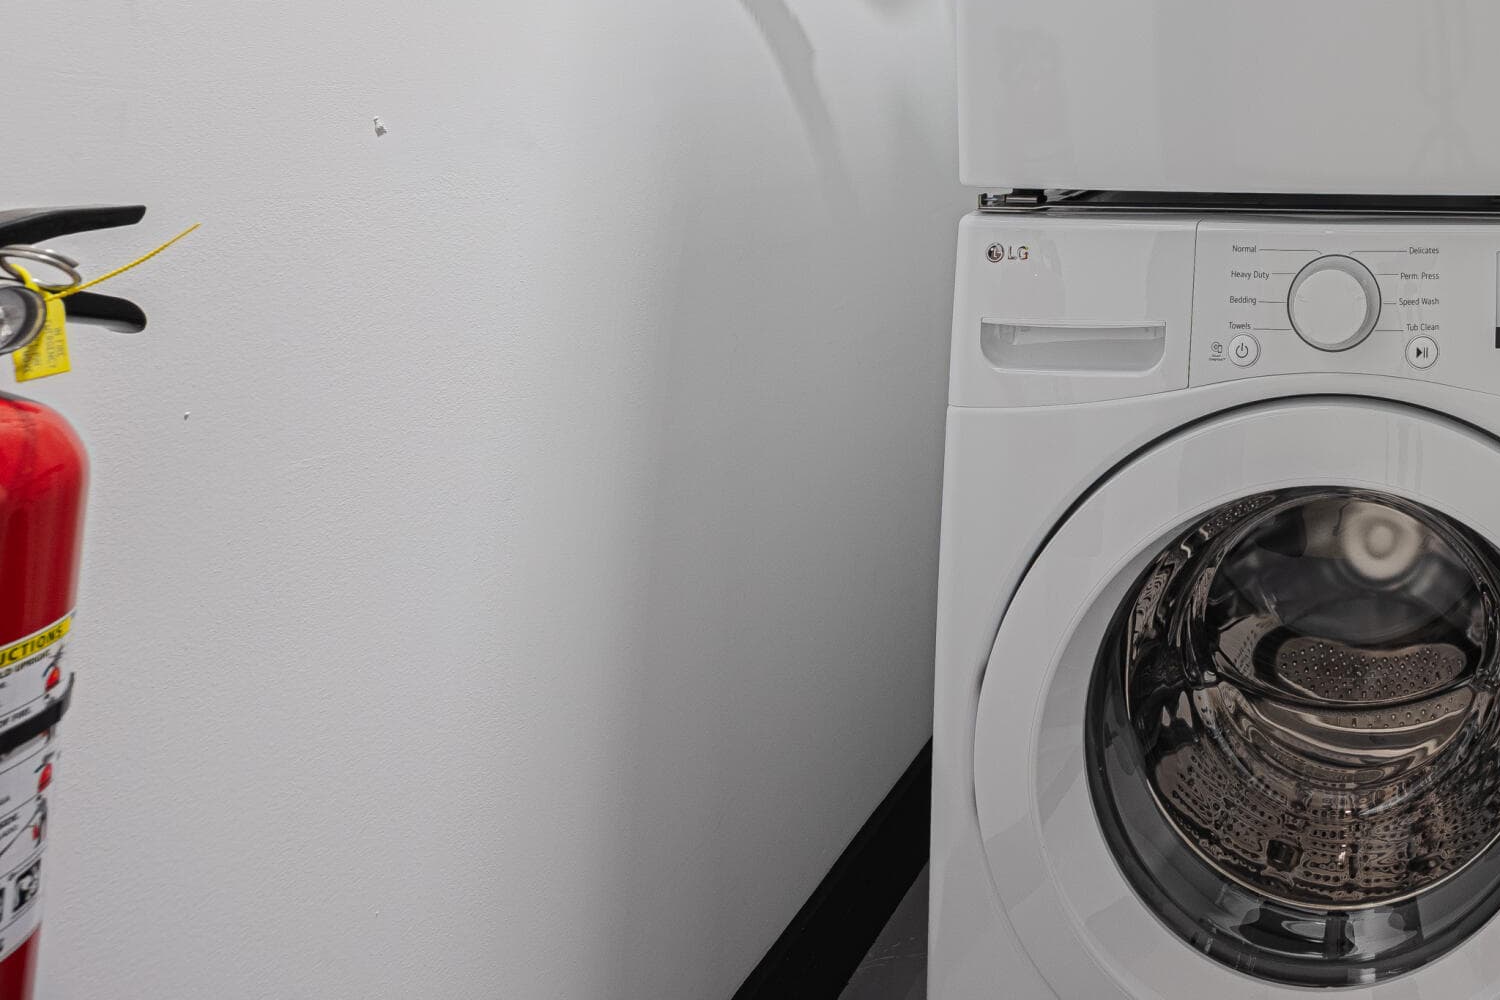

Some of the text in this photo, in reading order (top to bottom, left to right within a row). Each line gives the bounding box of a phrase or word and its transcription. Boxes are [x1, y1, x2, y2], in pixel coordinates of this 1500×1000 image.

[1007, 246, 1029, 260] LG
[1232, 245, 1257, 253] Normal
[1409, 246, 1439, 254] Delicates
[1231, 270, 1269, 280] Heavy Duty
[1400, 272, 1440, 280] Perm. Press
[1230, 296, 1257, 305] Bedding
[1399, 298, 1419, 307] Speed
[1228, 321, 1252, 330] Towels
[1406, 323, 1440, 331] Tub Clean
